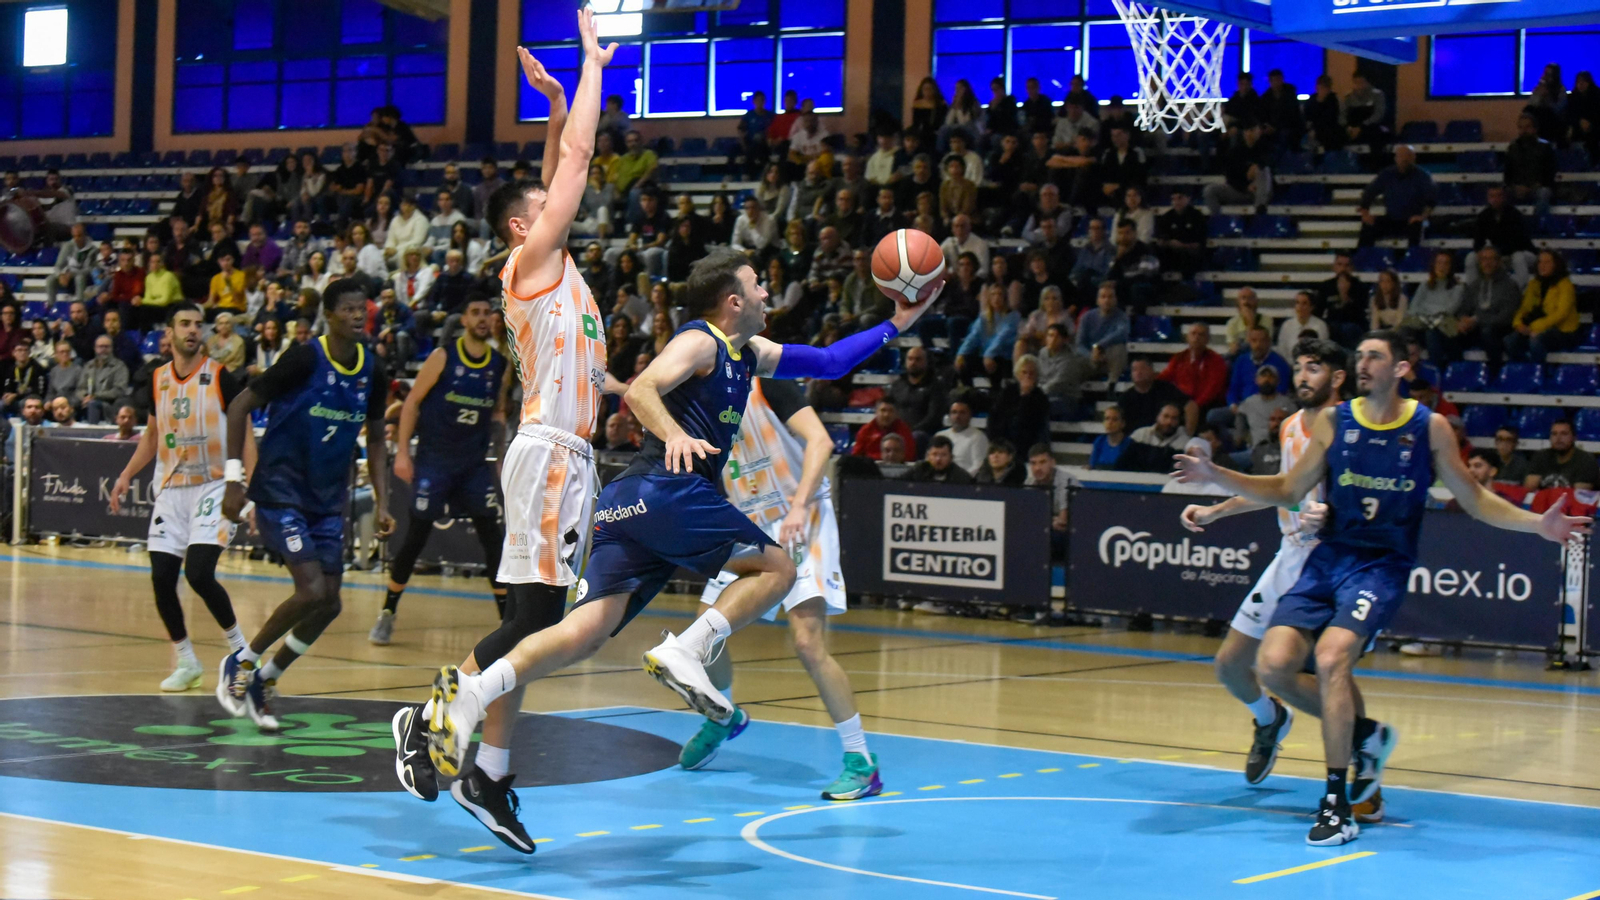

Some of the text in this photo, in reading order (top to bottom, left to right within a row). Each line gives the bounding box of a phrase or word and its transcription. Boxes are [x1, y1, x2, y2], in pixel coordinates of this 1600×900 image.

[172, 397, 191, 420] 33
[456, 409, 479, 425] 23
[321, 425, 338, 442] 7
[40, 472, 87, 495] Frida
[890, 502, 928, 521] BAR
[1361, 496, 1380, 521] 3
[890, 520, 997, 543] CAFETERÍA
[895, 552, 992, 577] CENTRO
[1113, 538, 1251, 570] populares
[1181, 570, 1251, 587] de Algeciras
[1407, 563, 1532, 601] mex.io
[1351, 598, 1372, 621] 3
